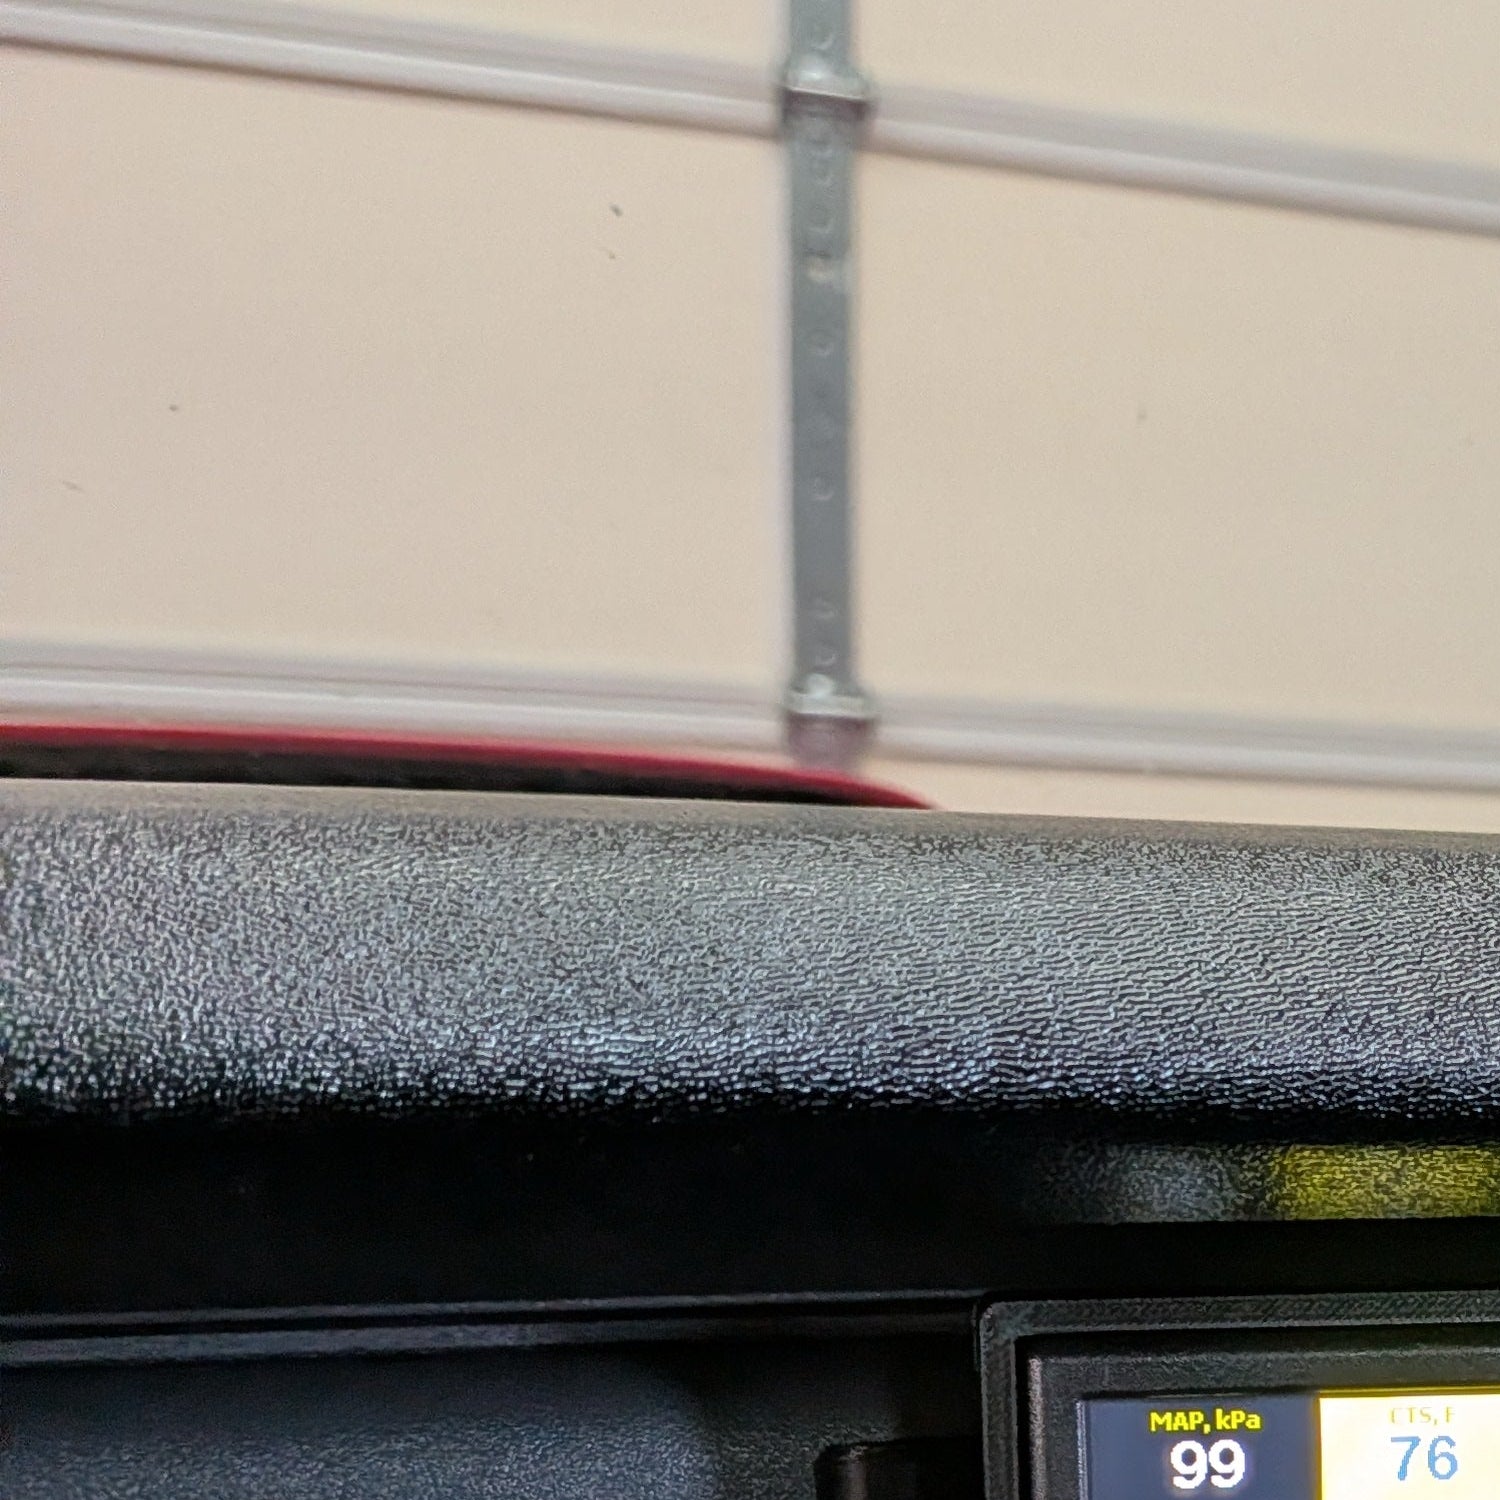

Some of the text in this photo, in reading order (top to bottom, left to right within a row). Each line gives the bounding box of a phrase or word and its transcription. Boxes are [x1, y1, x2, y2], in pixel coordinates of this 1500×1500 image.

[1150, 1408, 1262, 1434] MAP, kPa
[1170, 1438, 1246, 1489] 99
[1390, 1435, 1458, 1481] 76
